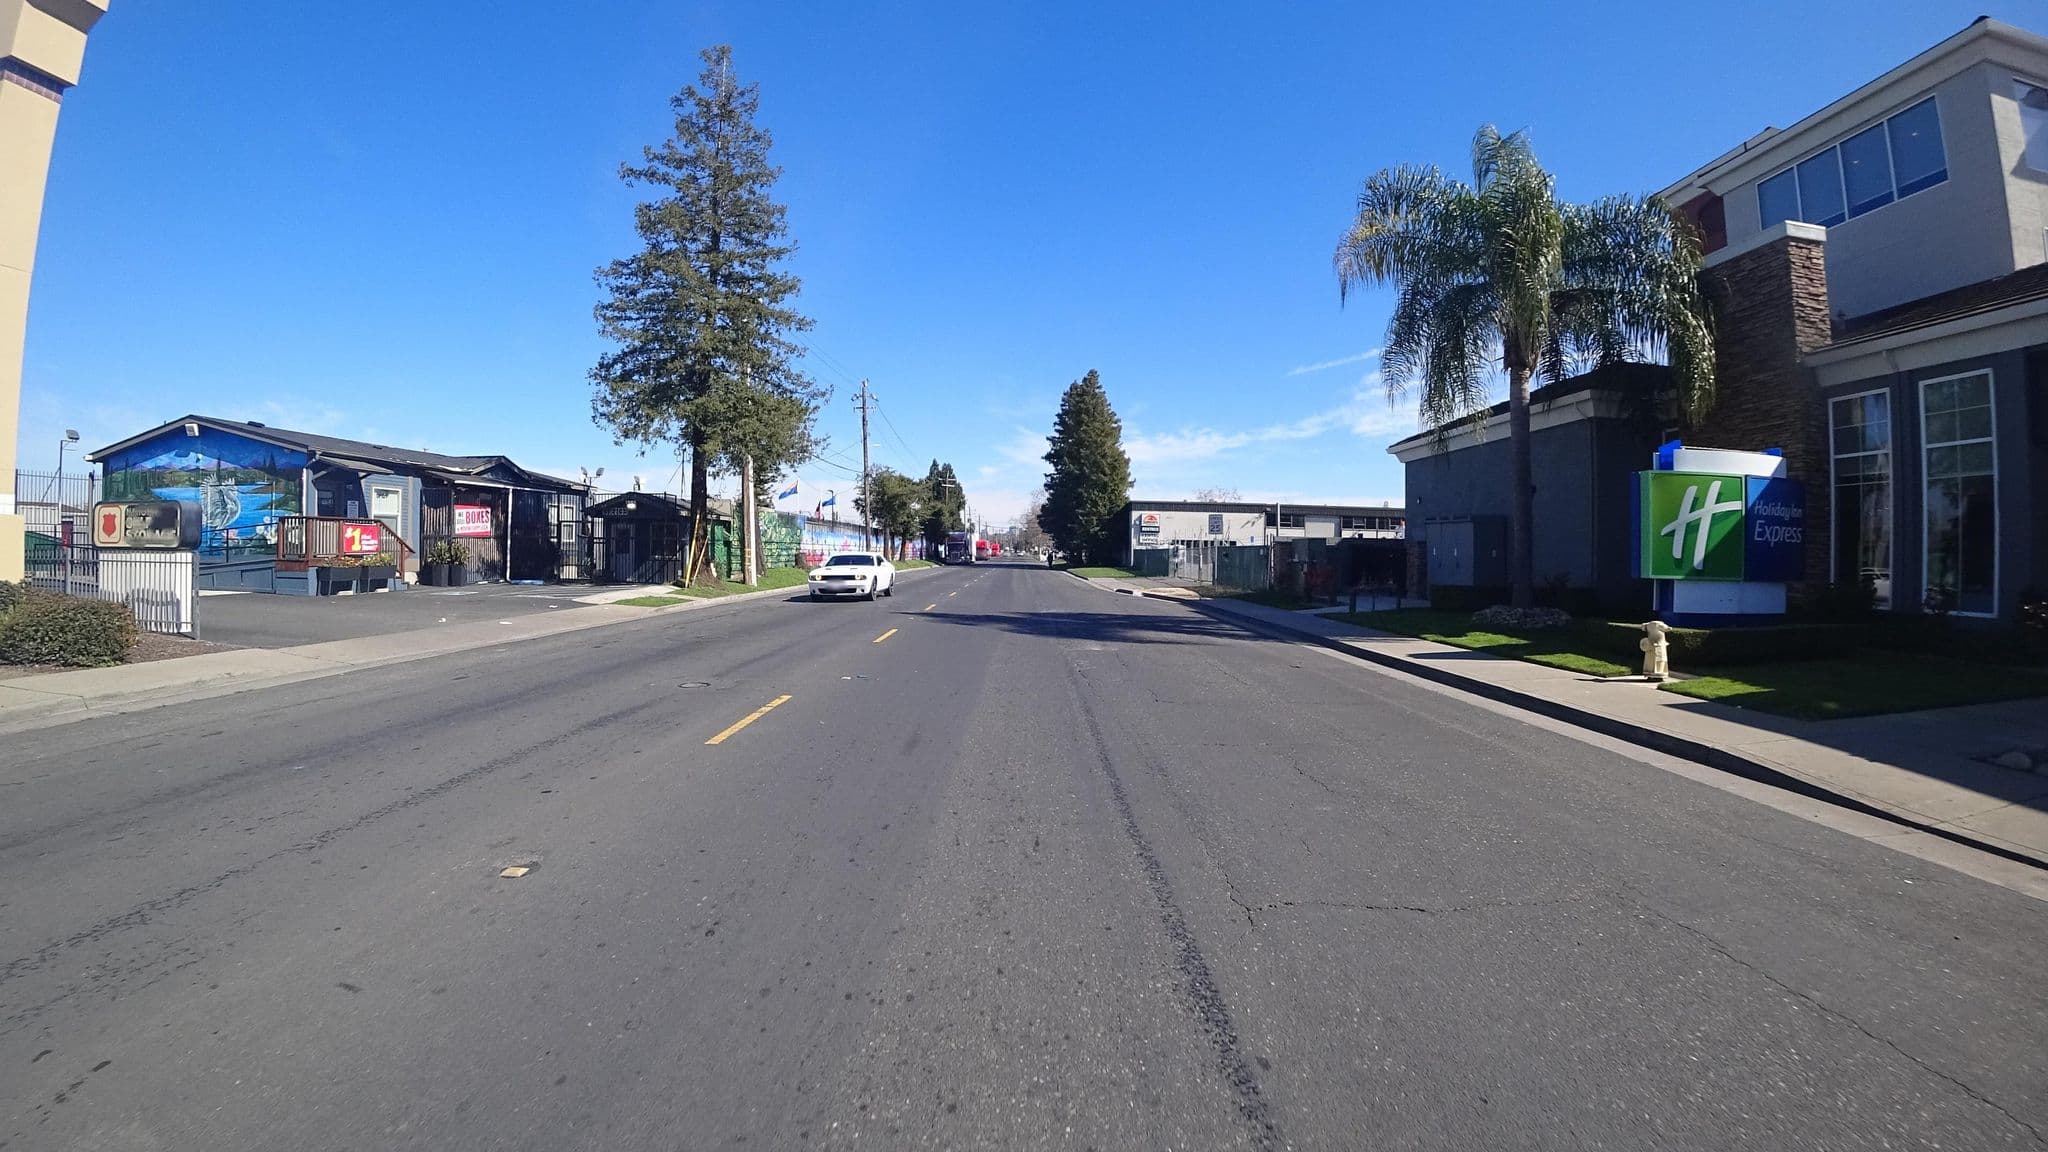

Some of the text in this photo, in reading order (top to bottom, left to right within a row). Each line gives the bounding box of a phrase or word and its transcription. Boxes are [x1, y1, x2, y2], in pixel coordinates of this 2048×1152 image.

[465, 510, 490, 524] BOXES
[1754, 500, 1790, 520] Holiday
[1754, 519, 1802, 547] Express
